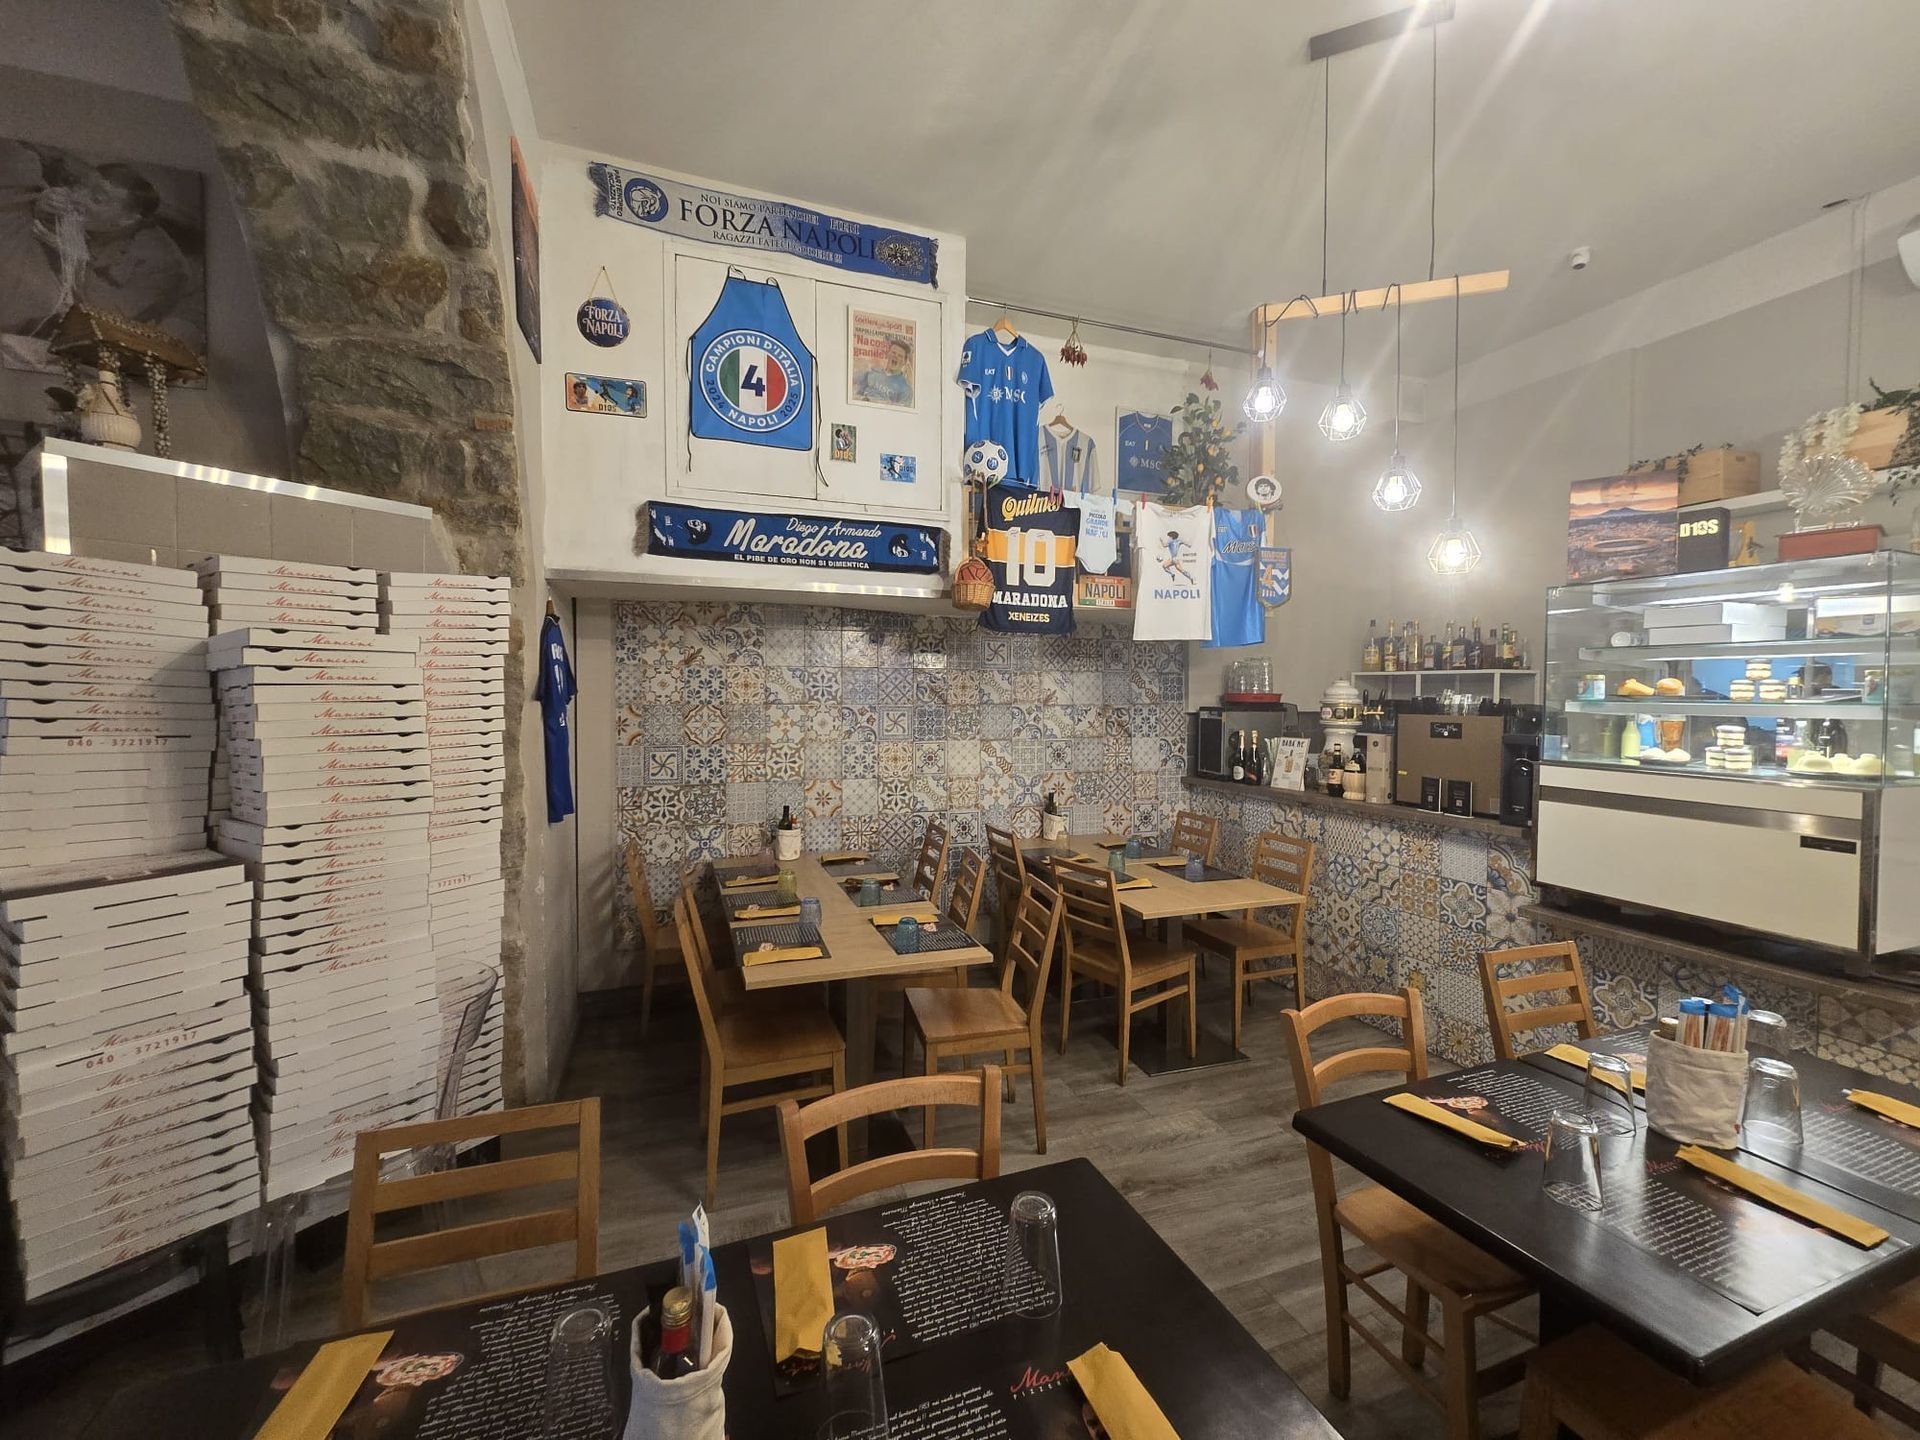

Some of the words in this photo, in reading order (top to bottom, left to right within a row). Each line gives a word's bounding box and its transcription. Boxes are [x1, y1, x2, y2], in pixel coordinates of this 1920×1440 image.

[700, 193, 721, 206] NOI
[725, 198, 757, 212] SIAMO
[679, 198, 776, 237] FORZA
[783, 218, 876, 260] NAPOLI
[713, 230, 755, 245] RAGAZZI
[758, 236, 791, 250] FATECI
[584, 306, 622, 323] FORZA
[582, 318, 624, 338] NAPOLI
[705, 335, 761, 373] CAMPIONI
[763, 340, 799, 386] D'ITALIA
[741, 364, 766, 397] 4
[706, 380, 725, 409] 2024
[728, 409, 778, 427] NAPOLI
[780, 392, 799, 418] 2025
[1140, 458, 1162, 470] MSC
[786, 518, 819, 537] Diego
[828, 520, 882, 537] Armando
[723, 518, 869, 559] Maradona
[734, 553, 745, 561] EL
[747, 554, 766, 562] PIBE
[768, 556, 779, 564] DE
[781, 557, 797, 565] ORO
[799, 558, 816, 566] NON
[829, 560, 870, 569] DIMENTICA
[1005, 526, 1057, 587] 10
[51, 557, 143, 577] Mancini
[993, 590, 1068, 608] MARADONA
[1085, 583, 1126, 600] NAPOLI
[1154, 589, 1201, 600] NAPOLI
[1008, 611, 1051, 623] XENEIZES
[86, 1055, 114, 1069] 040
[135, 1031, 198, 1054] 3721917
